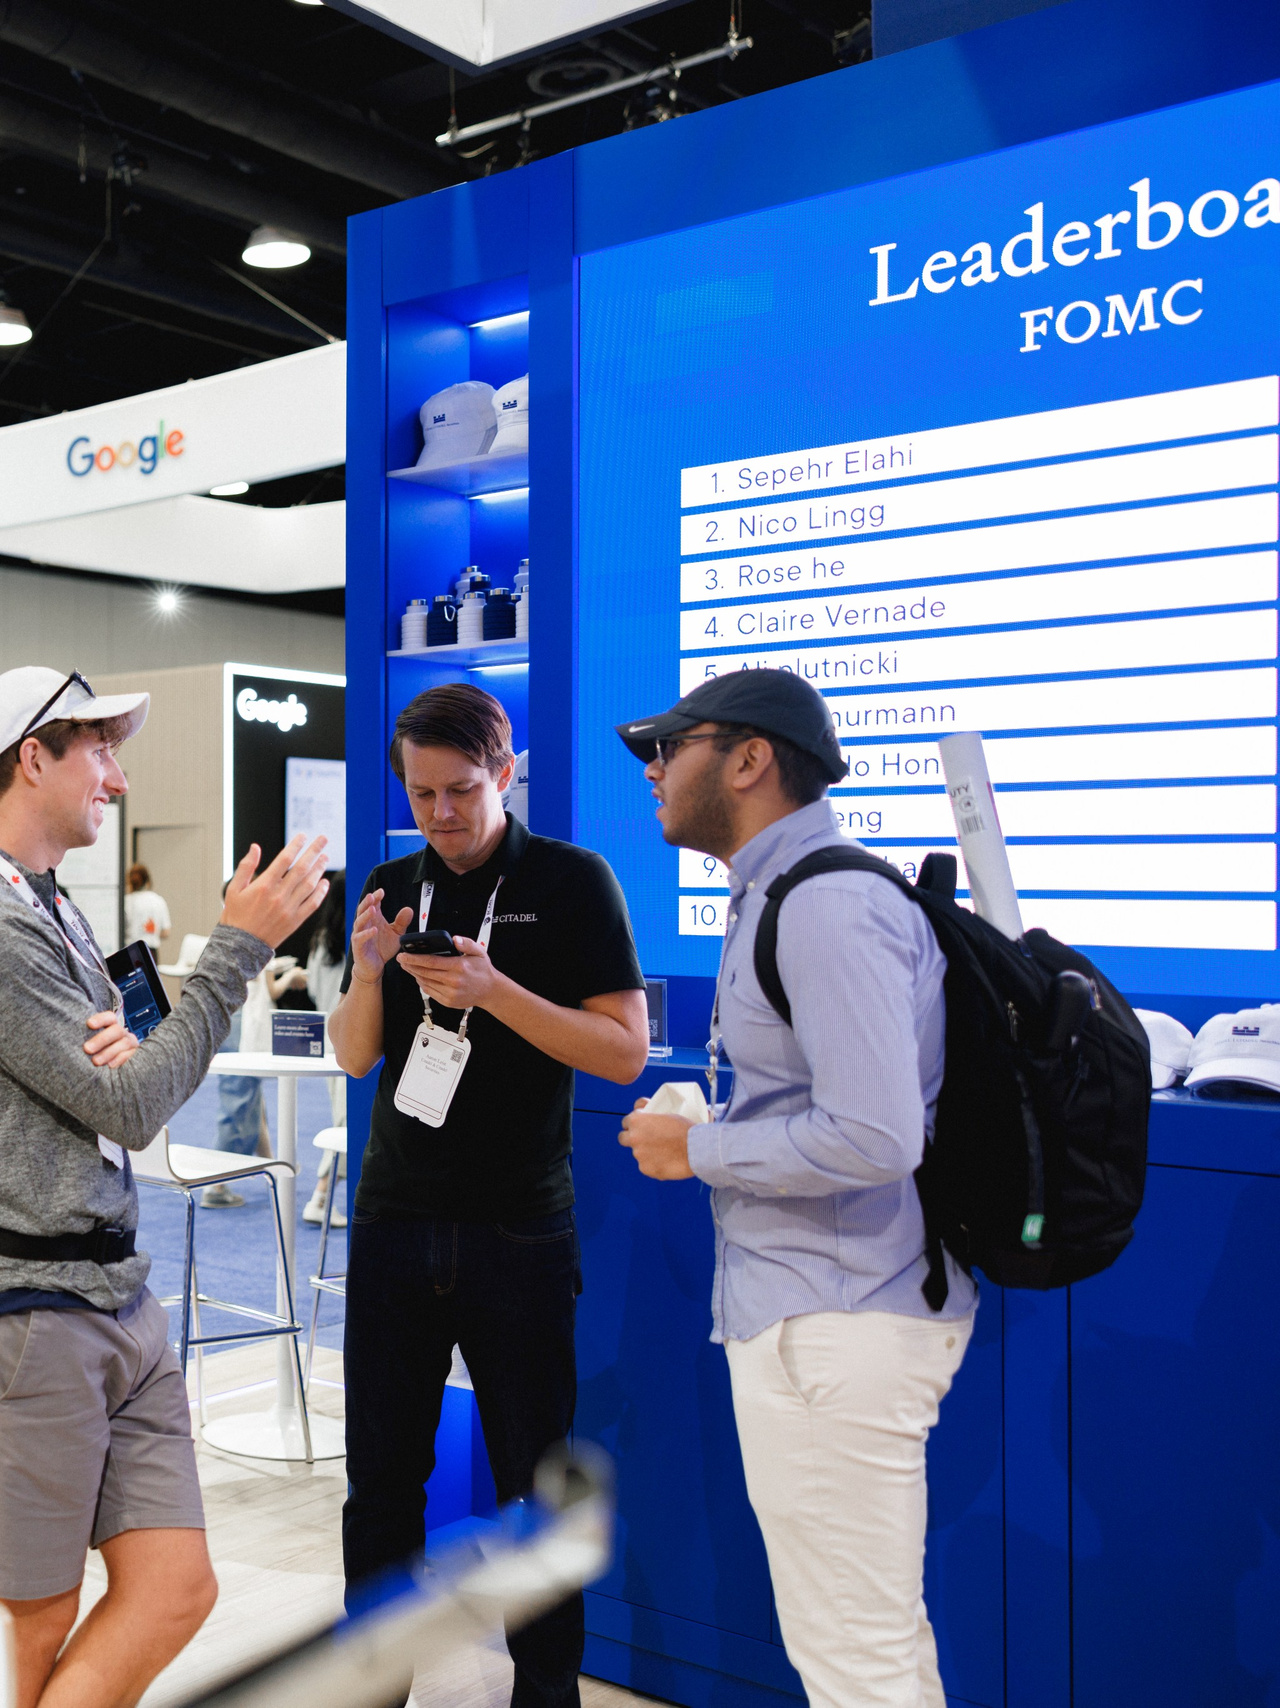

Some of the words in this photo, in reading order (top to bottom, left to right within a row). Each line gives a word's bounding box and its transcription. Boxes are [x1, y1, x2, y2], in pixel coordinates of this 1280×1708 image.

[868, 177, 1280, 307] Leaderboa
[1020, 278, 1204, 353] FOMC
[67, 419, 184, 477] Google
[711, 472, 725, 494] 1.
[738, 458, 833, 490] Sepehr
[845, 443, 913, 475] Elahi
[705, 521, 725, 542] 2.
[739, 514, 797, 539] Nico
[809, 504, 885, 530] Lingg
[705, 568, 724, 591] 3.
[738, 564, 802, 587] Rose
[813, 557, 845, 579] he
[704, 616, 724, 638] 4.
[737, 610, 815, 635] Claire
[825, 596, 946, 627] Vernade
[237, 688, 307, 731] Google
[703, 856, 722, 878] 9.
[498, 913, 538, 923] CITADEL
[690, 903, 723, 926] 10.
